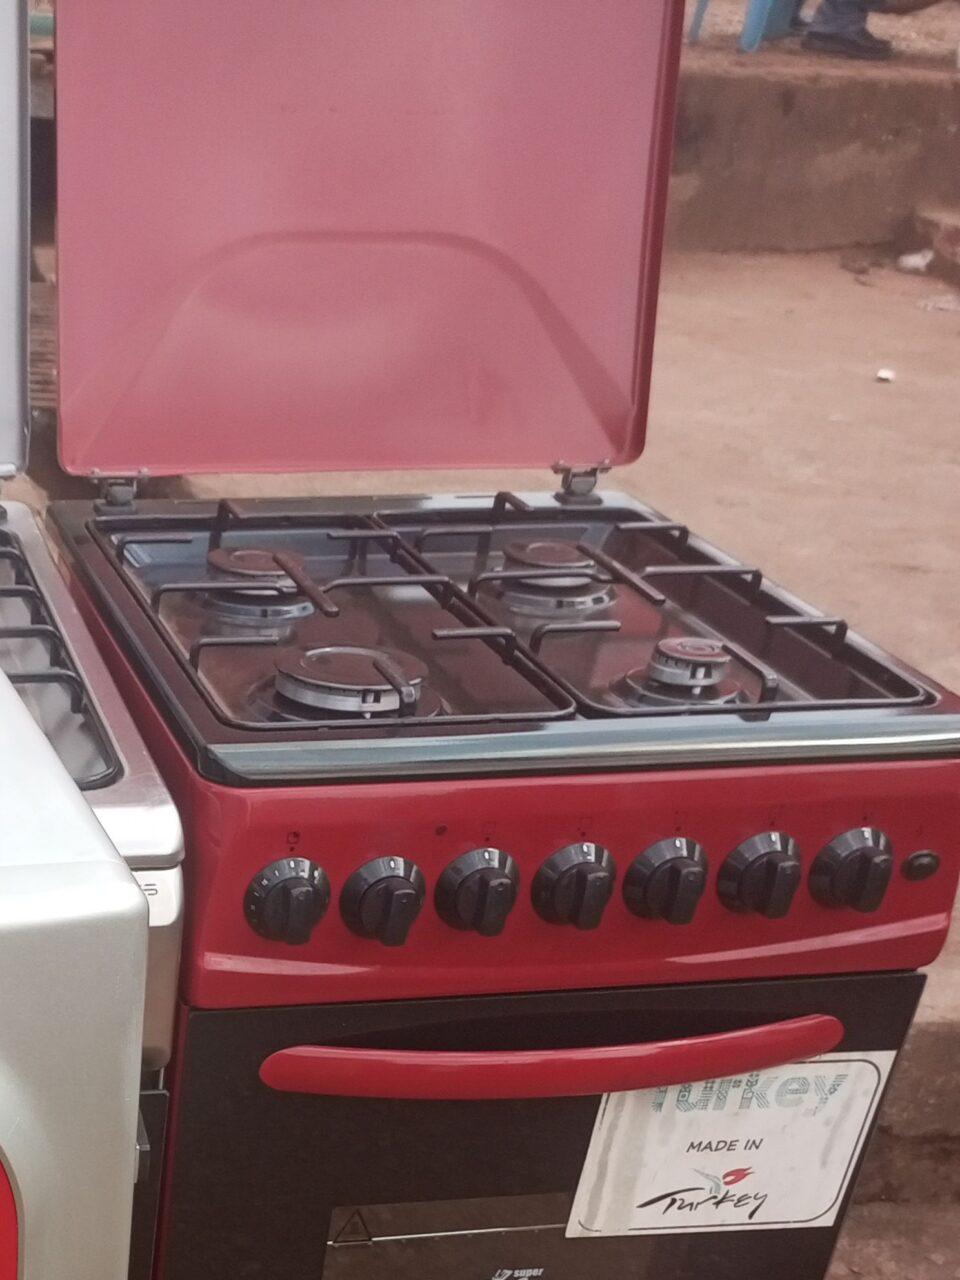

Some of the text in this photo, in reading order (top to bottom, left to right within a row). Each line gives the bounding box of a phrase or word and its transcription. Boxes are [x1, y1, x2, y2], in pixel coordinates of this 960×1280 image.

[686, 1138, 764, 1153] MADE IN
[637, 1187, 768, 1220] Turkey
[513, 1268, 545, 1277] super
